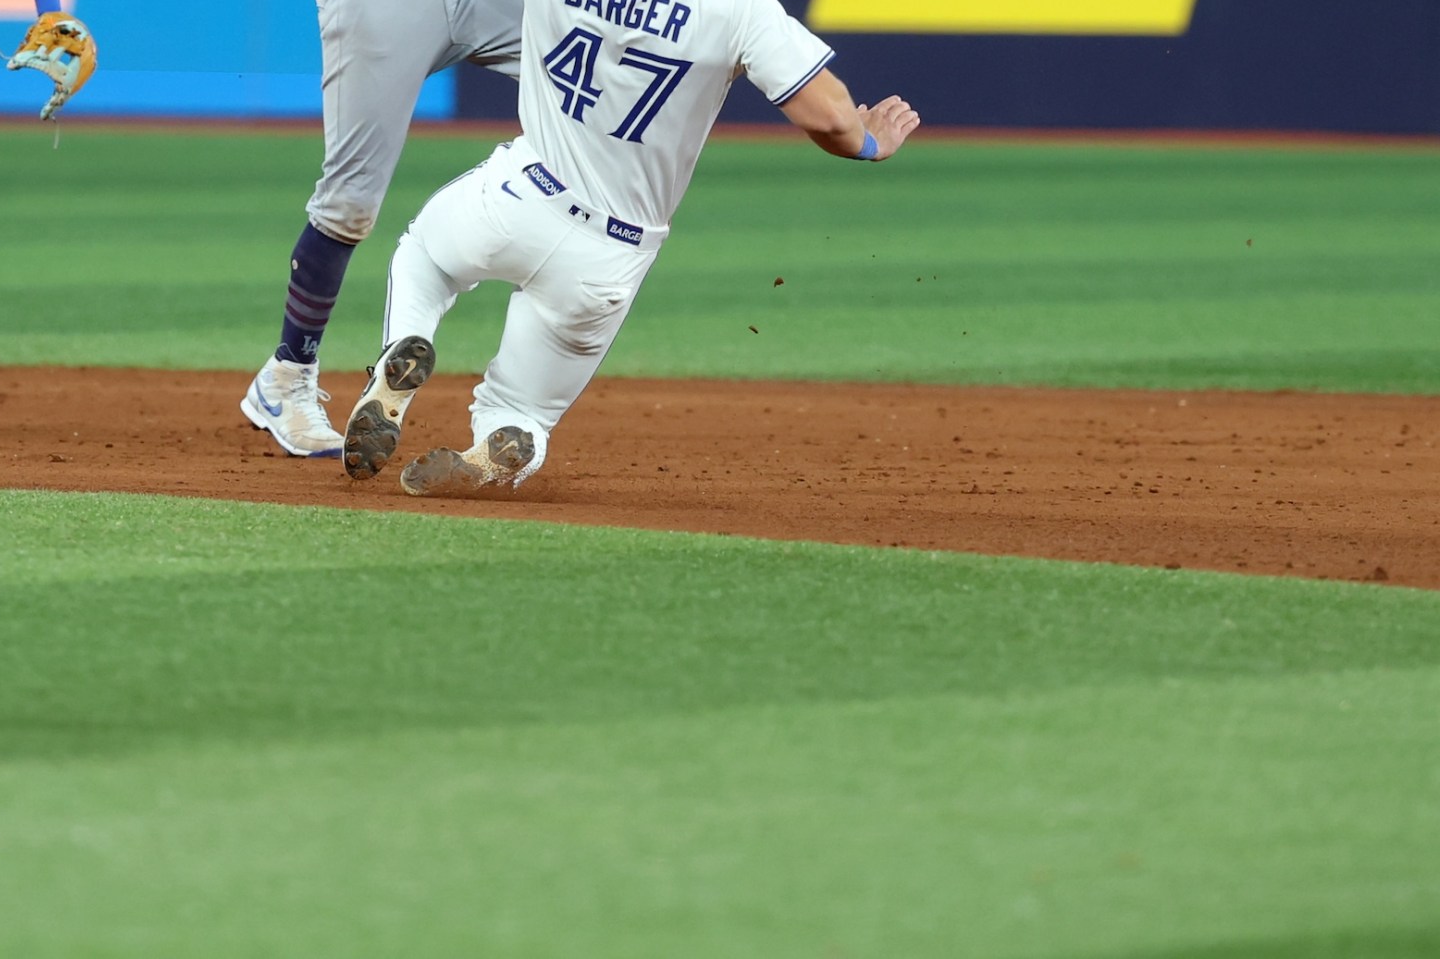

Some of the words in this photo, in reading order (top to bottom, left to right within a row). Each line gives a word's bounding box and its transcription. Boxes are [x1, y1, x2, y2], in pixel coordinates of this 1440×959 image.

[543, 26, 694, 144] 47
[527, 165, 560, 196] ADDISON
[609, 223, 643, 242] BARGE
[301, 335, 318, 356] LA
